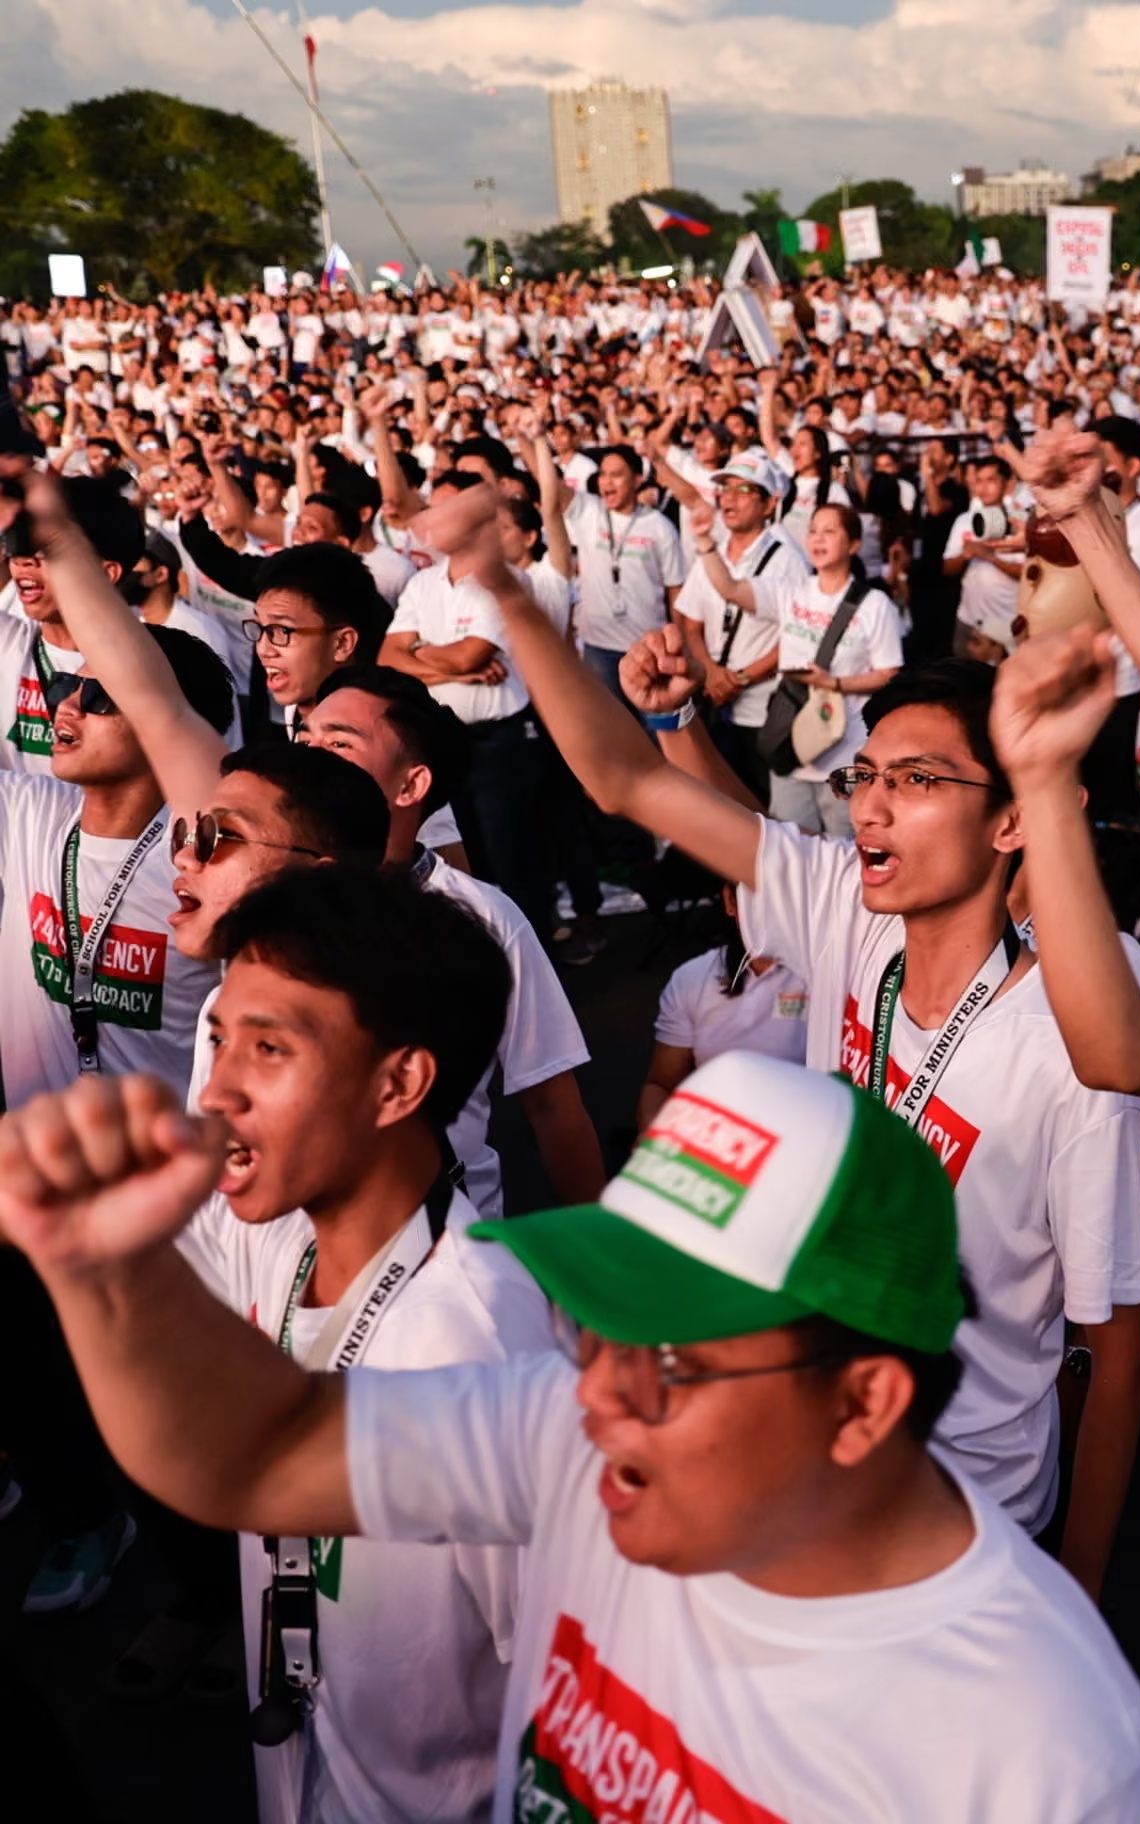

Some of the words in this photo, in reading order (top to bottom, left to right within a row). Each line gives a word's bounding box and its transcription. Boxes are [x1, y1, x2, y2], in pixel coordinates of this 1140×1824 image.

[82, 910, 109, 961] SCHOOL
[105, 882, 123, 909] FOR
[118, 820, 165, 881] MINISTERS
[903, 1074, 931, 1112] FOR
[925, 980, 990, 1074] MINISTERS
